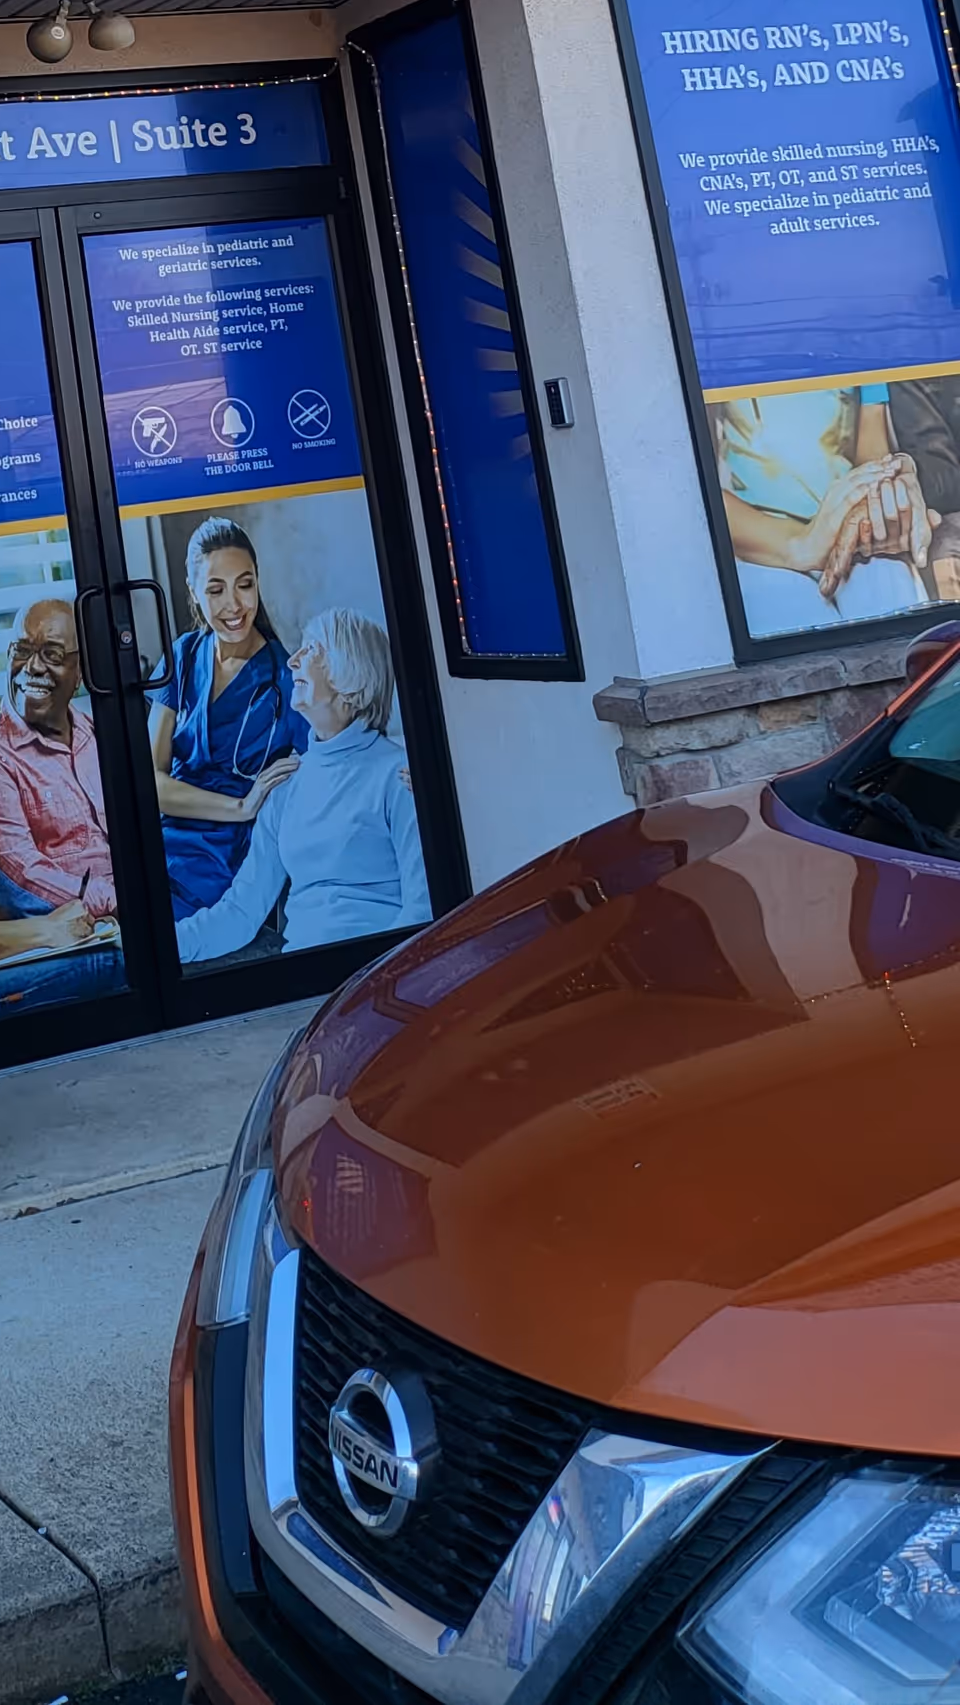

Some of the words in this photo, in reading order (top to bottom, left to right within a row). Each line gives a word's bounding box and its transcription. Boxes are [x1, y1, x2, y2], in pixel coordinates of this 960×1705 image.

[661, 26, 759, 54] HIRING
[763, 24, 829, 51] RN's,
[832, 20, 909, 47] LPN's,
[681, 64, 767, 92] HHA's,
[773, 60, 829, 87] AND
[835, 55, 905, 82] CNA's
[26, 126, 98, 160] Ave
[133, 115, 228, 152] Suite
[237, 112, 257, 145] 3
[679, 152, 705, 169] We
[708, 147, 768, 171] provide
[772, 141, 823, 163] skilled
[826, 140, 888, 159] nursing,
[751, 172, 776, 190] PT,
[779, 169, 805, 187] OT,
[808, 165, 837, 183] and
[840, 165, 858, 181] ST
[862, 162, 928, 179] services.
[704, 199, 731, 216] We
[734, 193, 809, 217] specialize
[813, 191, 830, 208] in
[833, 186, 899, 209] pediatric
[903, 183, 932, 199] and
[770, 218, 810, 235] adult
[814, 214, 880, 231] services.
[119, 248, 139, 261] We
[141, 244, 200, 261] specialize
[217, 238, 269, 256] pediatric
[271, 235, 294, 249] and
[159, 260, 208, 277] geriatric
[211, 257, 262, 270] services.
[112, 299, 132, 311] We
[135, 294, 180, 312] provide
[183, 293, 203, 305] the
[205, 287, 261, 303] following
[264, 284, 314, 298] services:
[127, 311, 169, 327] Skilled
[171, 307, 220, 323] Nursing
[222, 304, 267, 318] service,
[269, 301, 304, 314] Home
[149, 326, 190, 342] Health
[193, 322, 220, 338] Aide
[223, 320, 268, 335] service,
[221, 338, 263, 353] service
[206, 451, 240, 463] PLEASE
[241, 448, 268, 459] PRESS
[225, 463, 251, 474] DOOR
[253, 459, 274, 470] BELL
[331, 1428, 398, 1489] NISSAN
